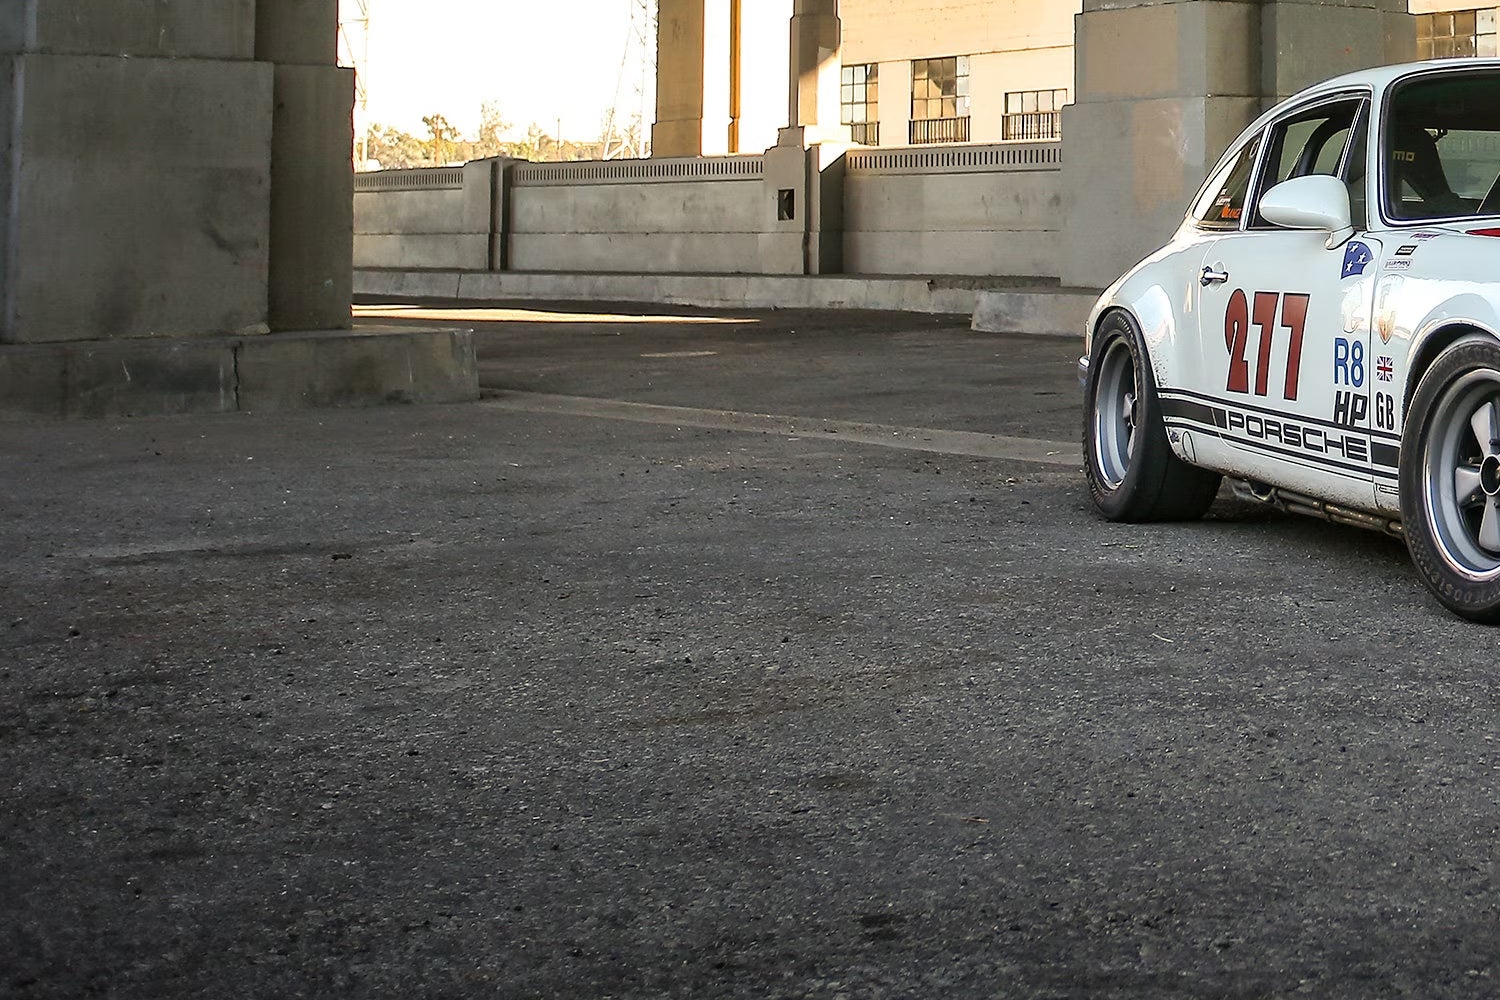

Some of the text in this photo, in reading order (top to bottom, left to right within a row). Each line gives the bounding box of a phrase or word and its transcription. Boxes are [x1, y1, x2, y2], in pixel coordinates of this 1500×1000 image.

[1224, 288, 1310, 401] 277
[1334, 338, 1364, 388] R8
[1333, 391, 1368, 427] HP
[1376, 391, 1395, 431] GB
[1227, 410, 1368, 462] PORSCHE
